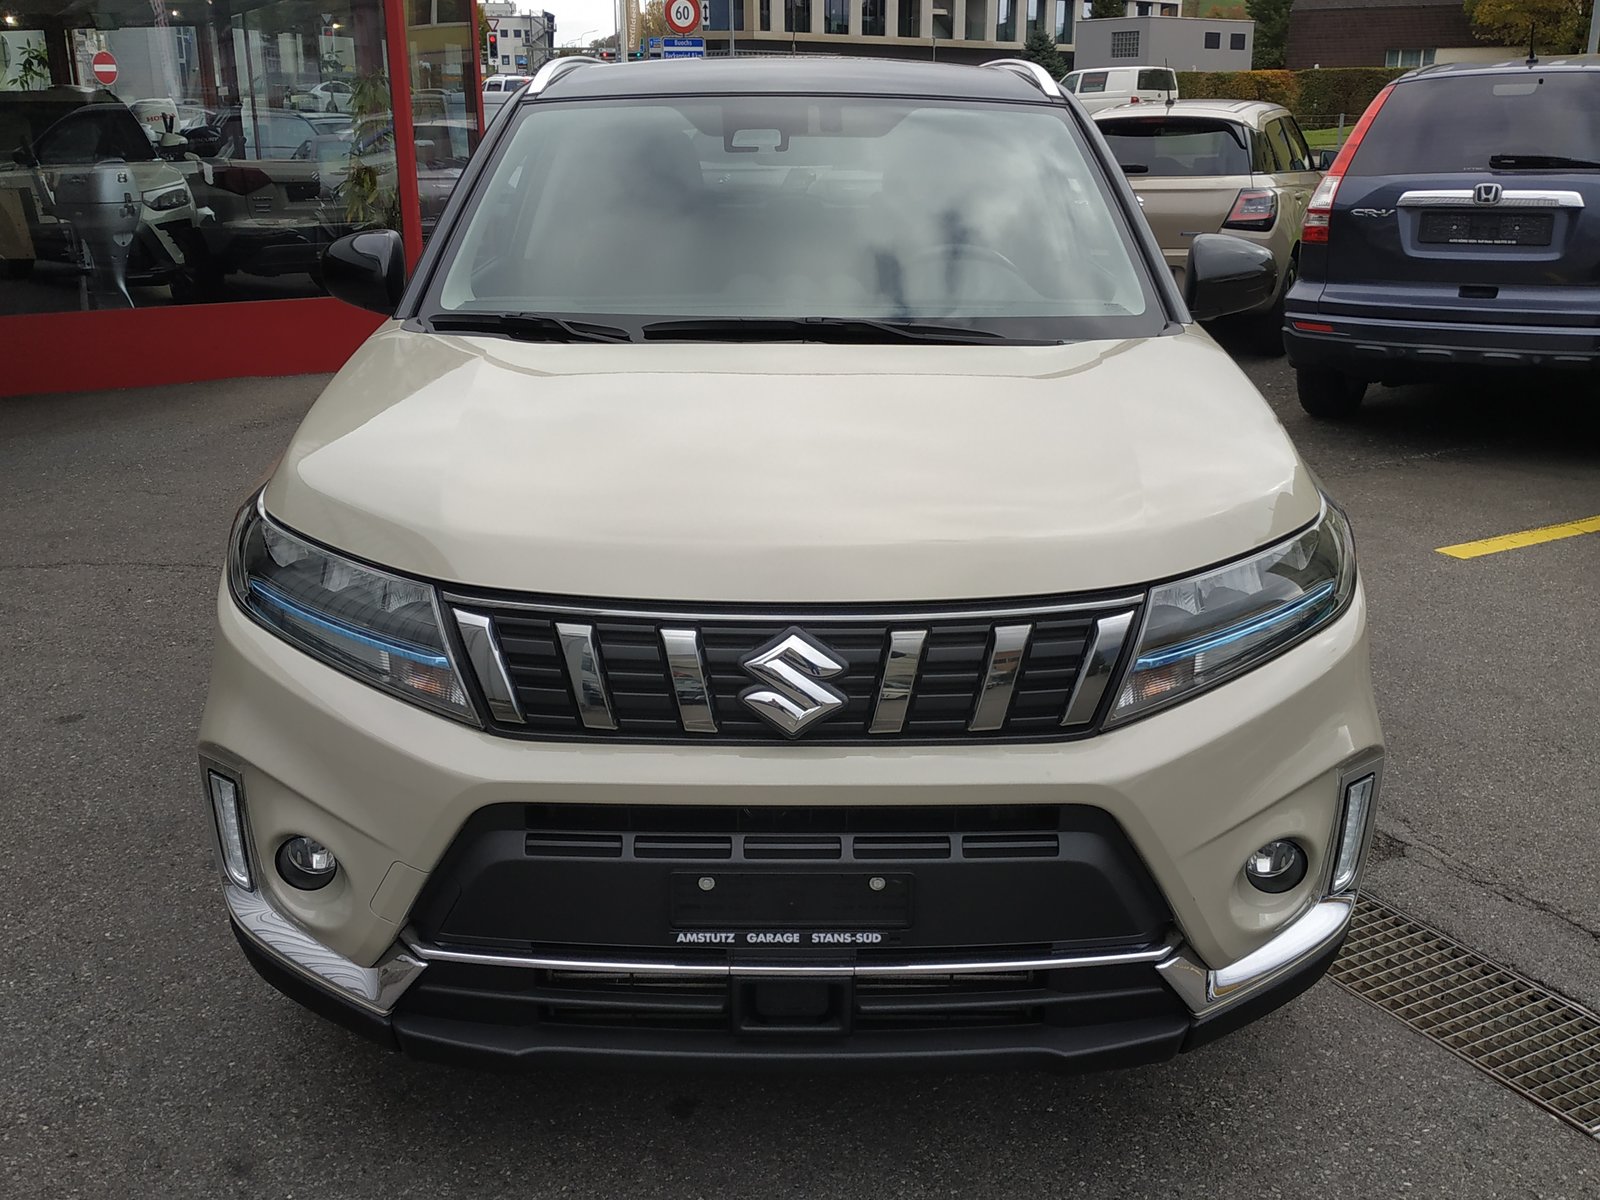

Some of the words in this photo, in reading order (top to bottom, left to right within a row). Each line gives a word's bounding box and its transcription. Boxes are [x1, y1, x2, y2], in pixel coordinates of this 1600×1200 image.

[675, 5, 690, 20] 60
[147, 113, 177, 122] HOA
[1351, 208, 1395, 218] CR-V
[676, 932, 736, 943] AMSTUTZ
[746, 932, 800, 943] GARAGE
[811, 932, 882, 943] STANS-SÜD
